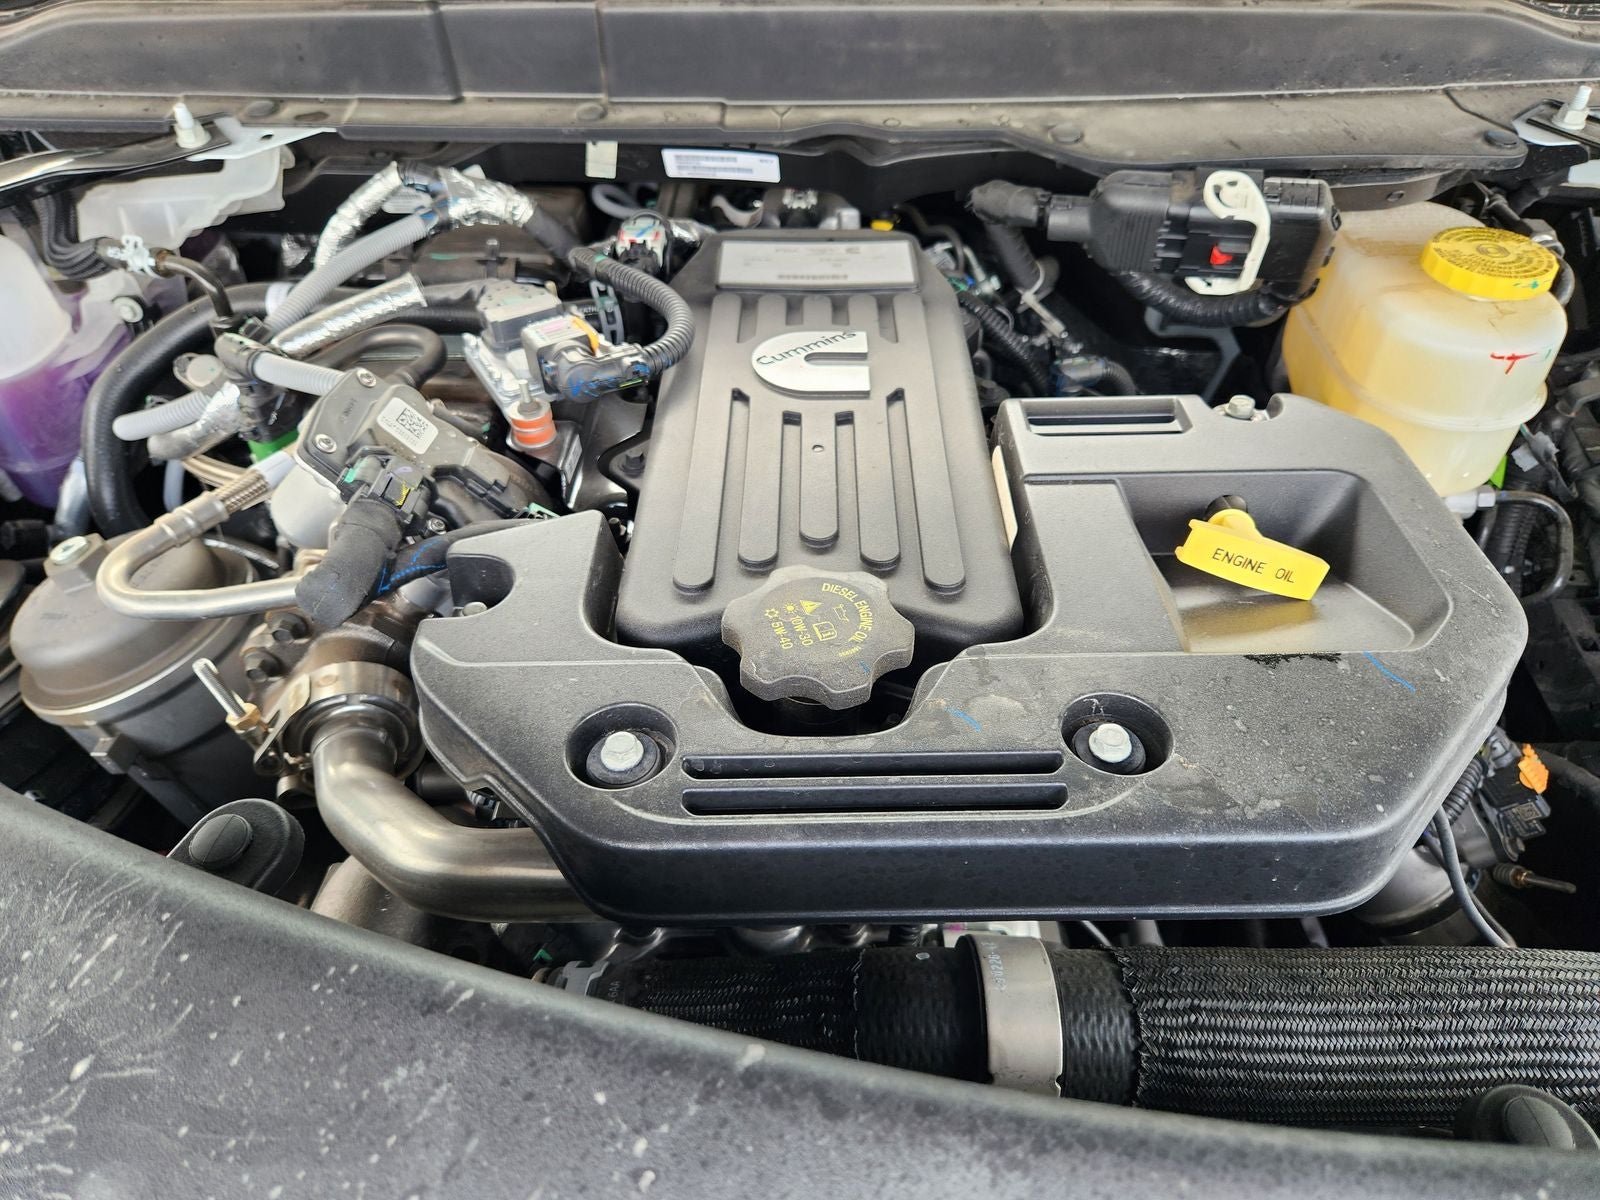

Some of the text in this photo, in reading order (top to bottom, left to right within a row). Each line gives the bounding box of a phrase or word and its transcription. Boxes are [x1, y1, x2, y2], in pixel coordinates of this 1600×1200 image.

[756, 331, 857, 365] Cummins
[1212, 547, 1295, 584] ENGINE OIL
[821, 582, 859, 602] DIESEL
[790, 615, 814, 647] 10W-30
[854, 599, 874, 633] ENGINE
[771, 620, 794, 650] 5W-40
[848, 630, 868, 644] OIL
